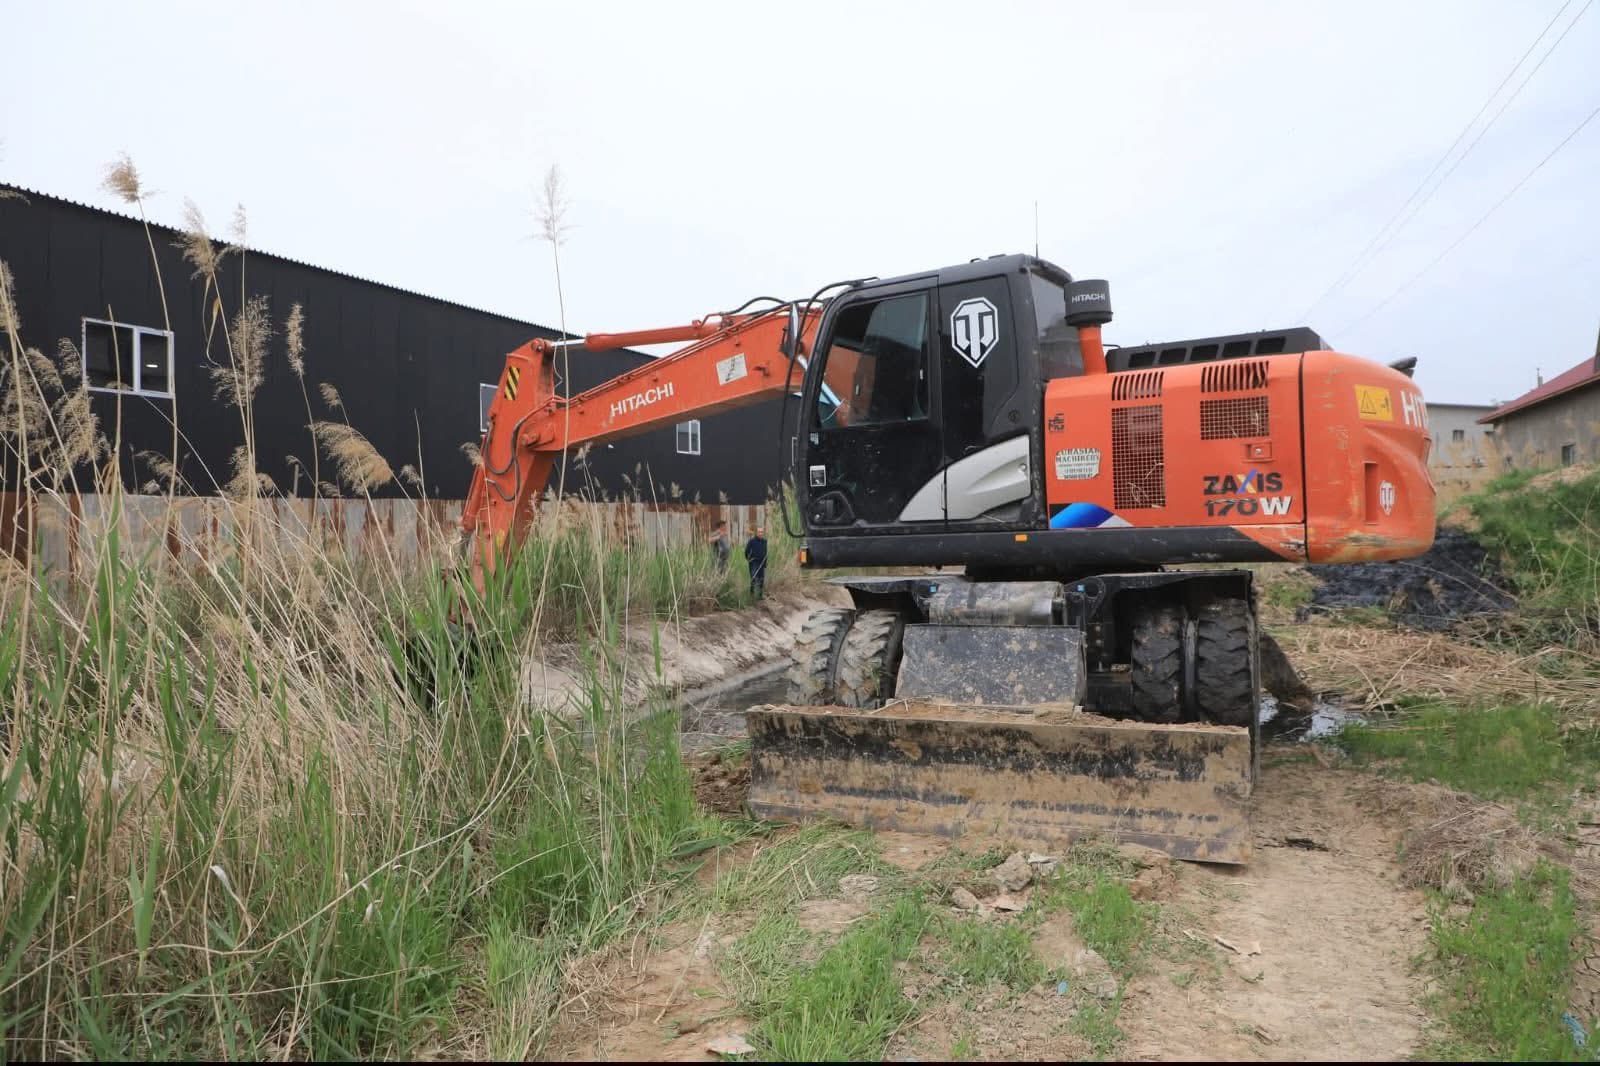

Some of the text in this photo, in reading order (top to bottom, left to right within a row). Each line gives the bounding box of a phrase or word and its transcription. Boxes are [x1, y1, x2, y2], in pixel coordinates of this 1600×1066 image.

[1071, 293, 1106, 304] HITACHI
[610, 382, 674, 417] HITACHI
[1203, 468, 1283, 496] ZAXIS
[1205, 496, 1292, 517] 170W
